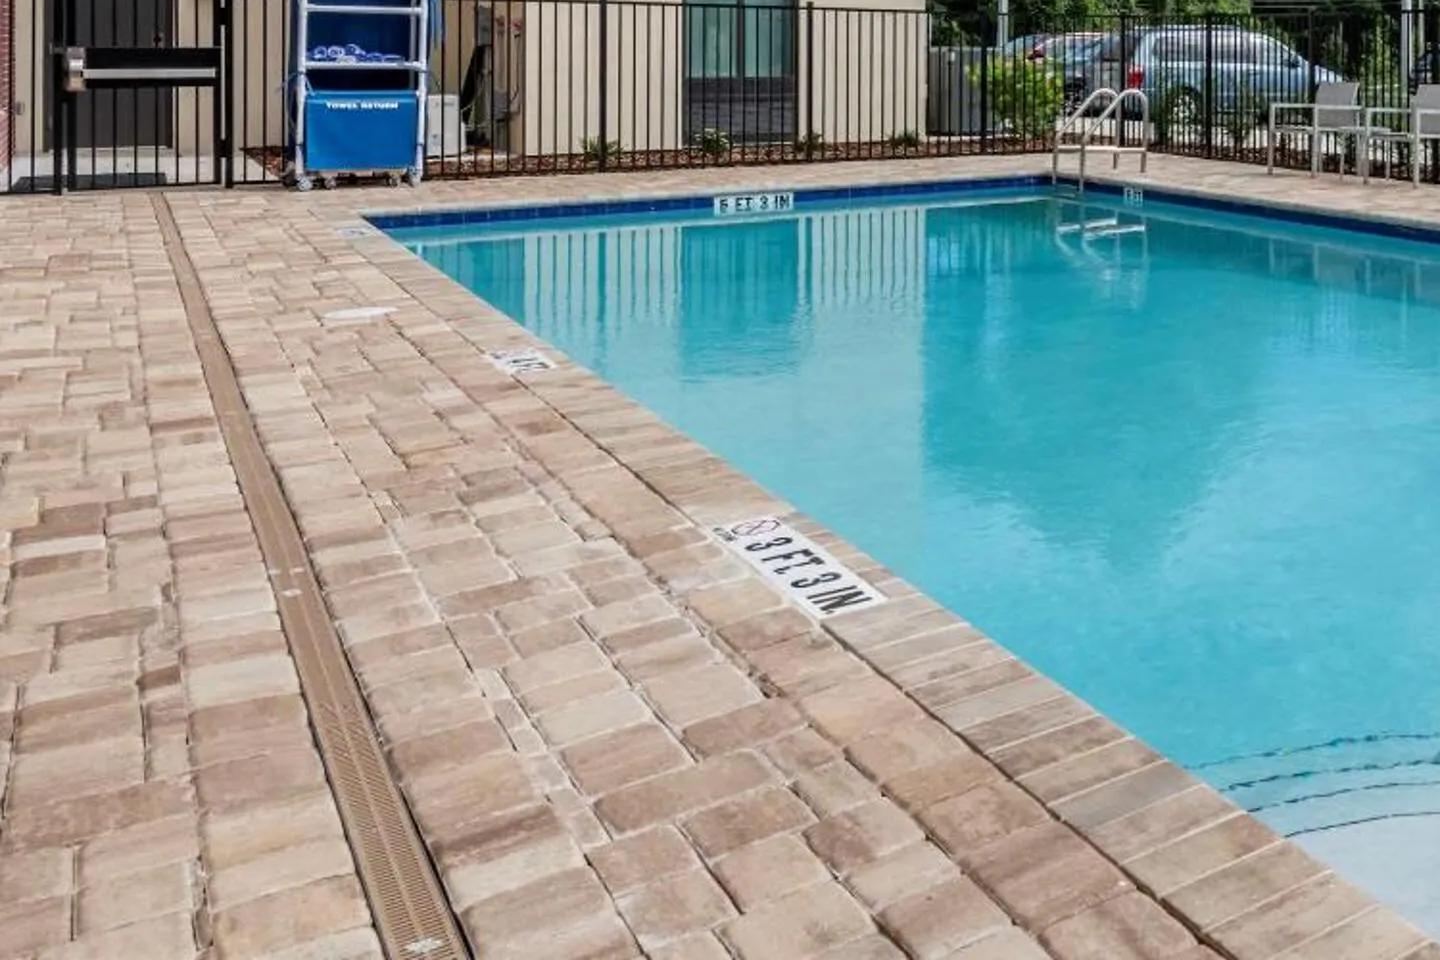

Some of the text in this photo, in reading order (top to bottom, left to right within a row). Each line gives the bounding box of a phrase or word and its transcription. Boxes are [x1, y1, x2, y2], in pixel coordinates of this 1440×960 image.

[324, 101, 399, 111] TOWEL RETURN
[744, 537, 793, 552] 3
[790, 572, 842, 588] 3
